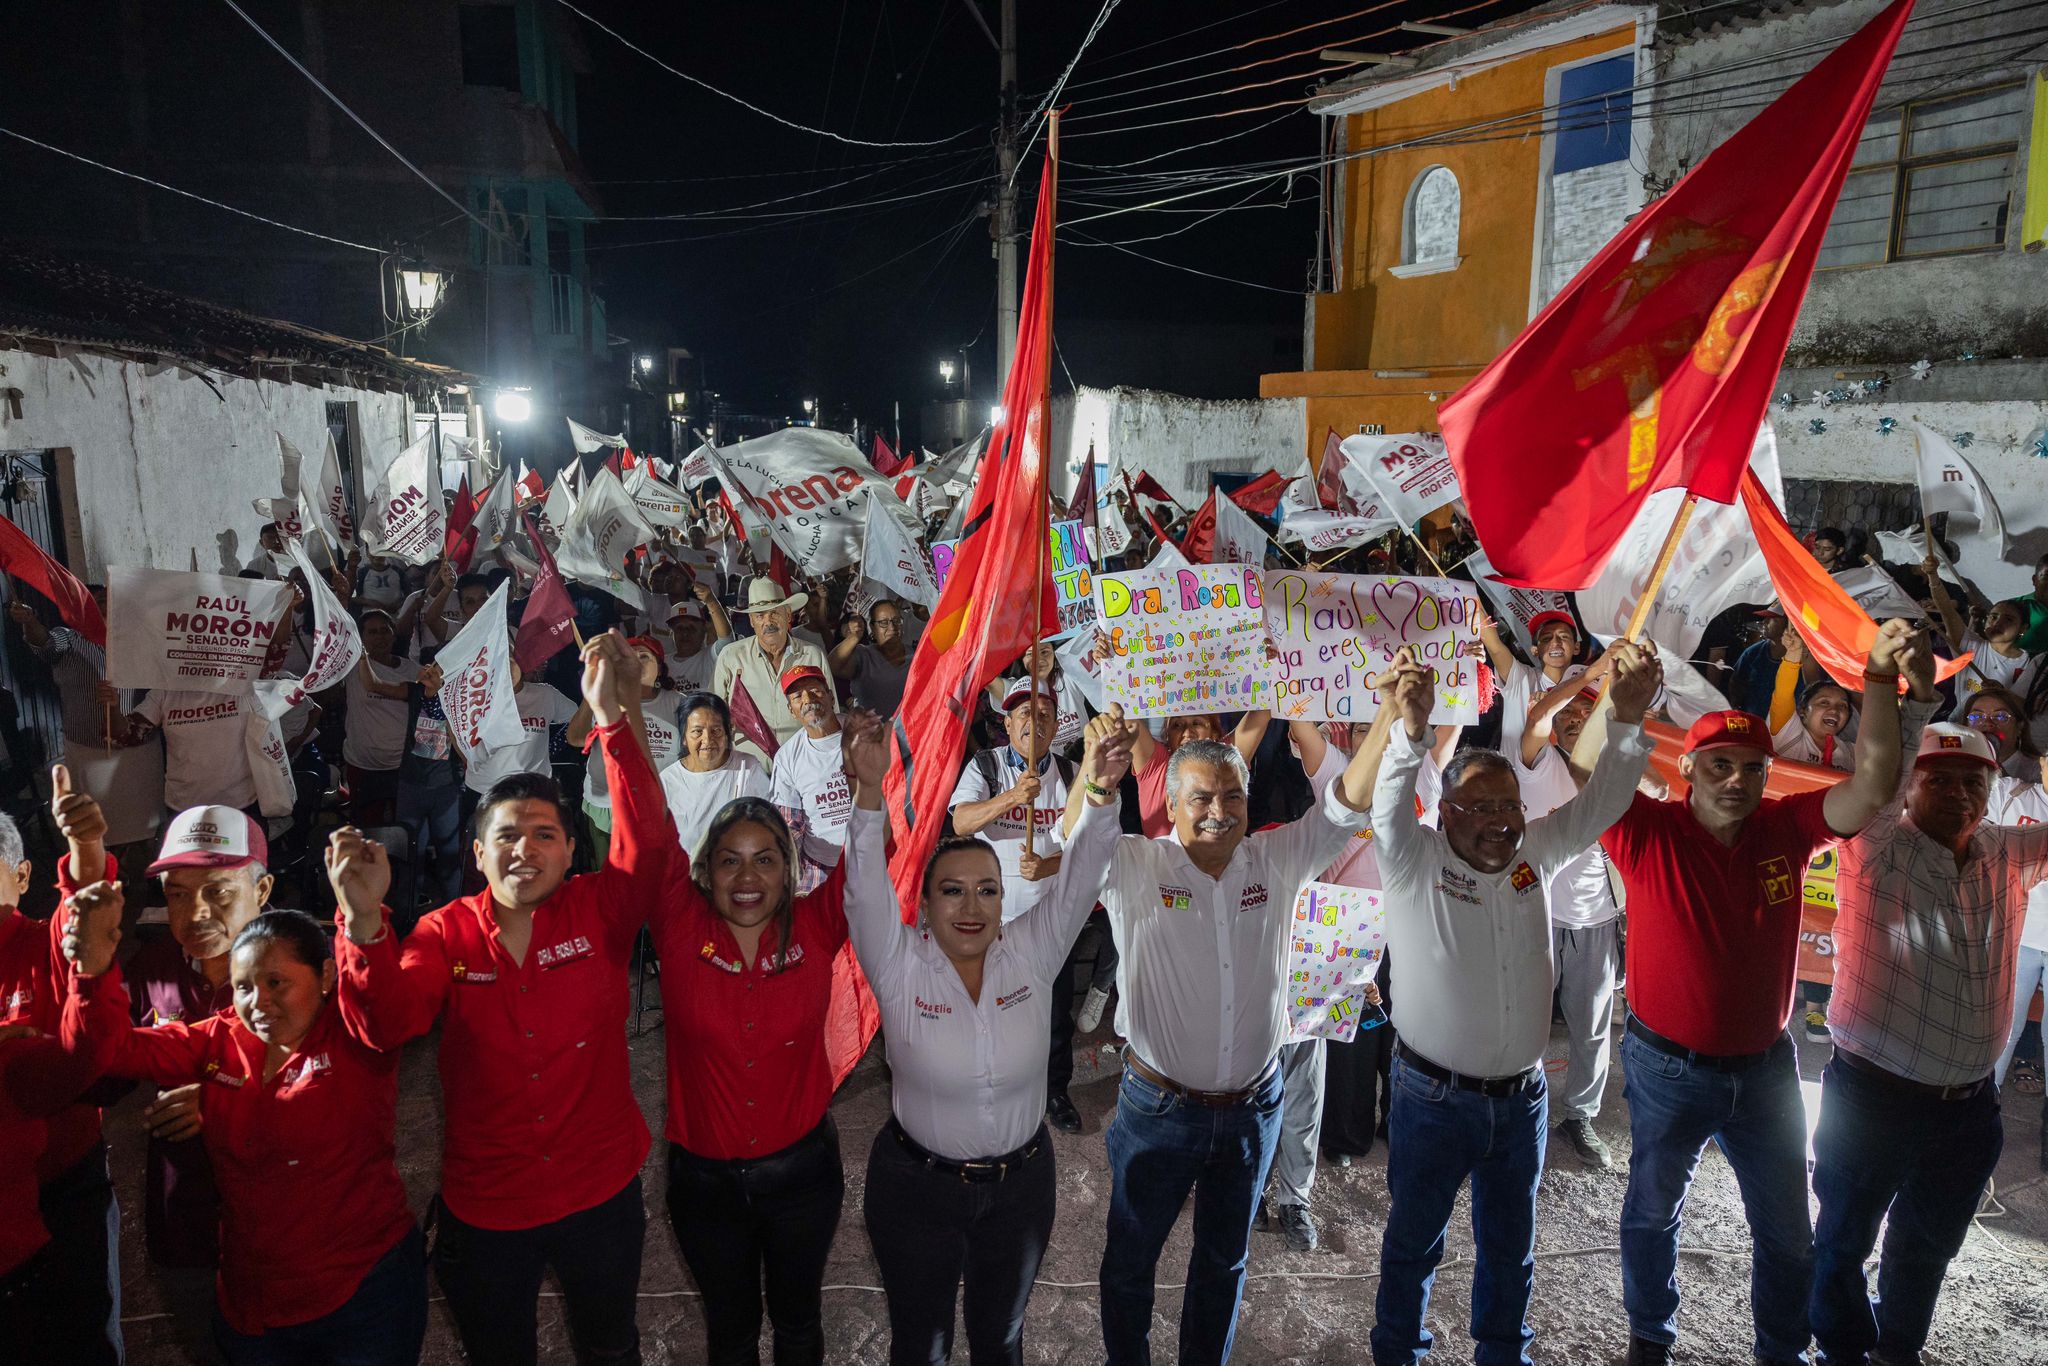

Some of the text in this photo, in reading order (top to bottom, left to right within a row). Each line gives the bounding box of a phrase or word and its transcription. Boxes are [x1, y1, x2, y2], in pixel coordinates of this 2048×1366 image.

[738, 460, 752, 470] LA
[756, 465, 784, 491] LUCH
[1419, 472, 1457, 499] moren
[805, 525, 821, 556] LUCHA
[1101, 578, 1168, 618] Dra.
[1177, 569, 1240, 610] Rosa
[196, 595, 251, 615] RAÚL
[1273, 575, 1479, 642] Raúl Morón
[166, 612, 275, 640] MORÓN
[186, 634, 250, 648] SENADOR
[1111, 623, 1184, 656] Cuitzeo
[169, 651, 207, 660] COMIENZA
[1277, 630, 1466, 680] ya eres snado
[178, 665, 225, 678] morena
[1128, 673, 1140, 688] la
[1145, 670, 1176, 689] mejor
[1274, 677, 1326, 713] para
[1335, 664, 1351, 690] el
[1446, 661, 1468, 688] de
[168, 701, 237, 720] morena
[1325, 688, 1351, 718] la
[815, 789, 849, 804] MOR
[828, 799, 852, 808] SENAD
[1511, 867, 1534, 887] PT
[1766, 874, 1789, 899] PT
[1159, 886, 1192, 898] morena
[1242, 883, 1267, 898] RAÚL
[1240, 893, 1268, 909] MORÓ
[555, 940, 576, 959] ROSA
[574, 936, 592, 953] ELIA
[453, 966, 466, 977] PT
[915, 996, 933, 1012] Rosa
